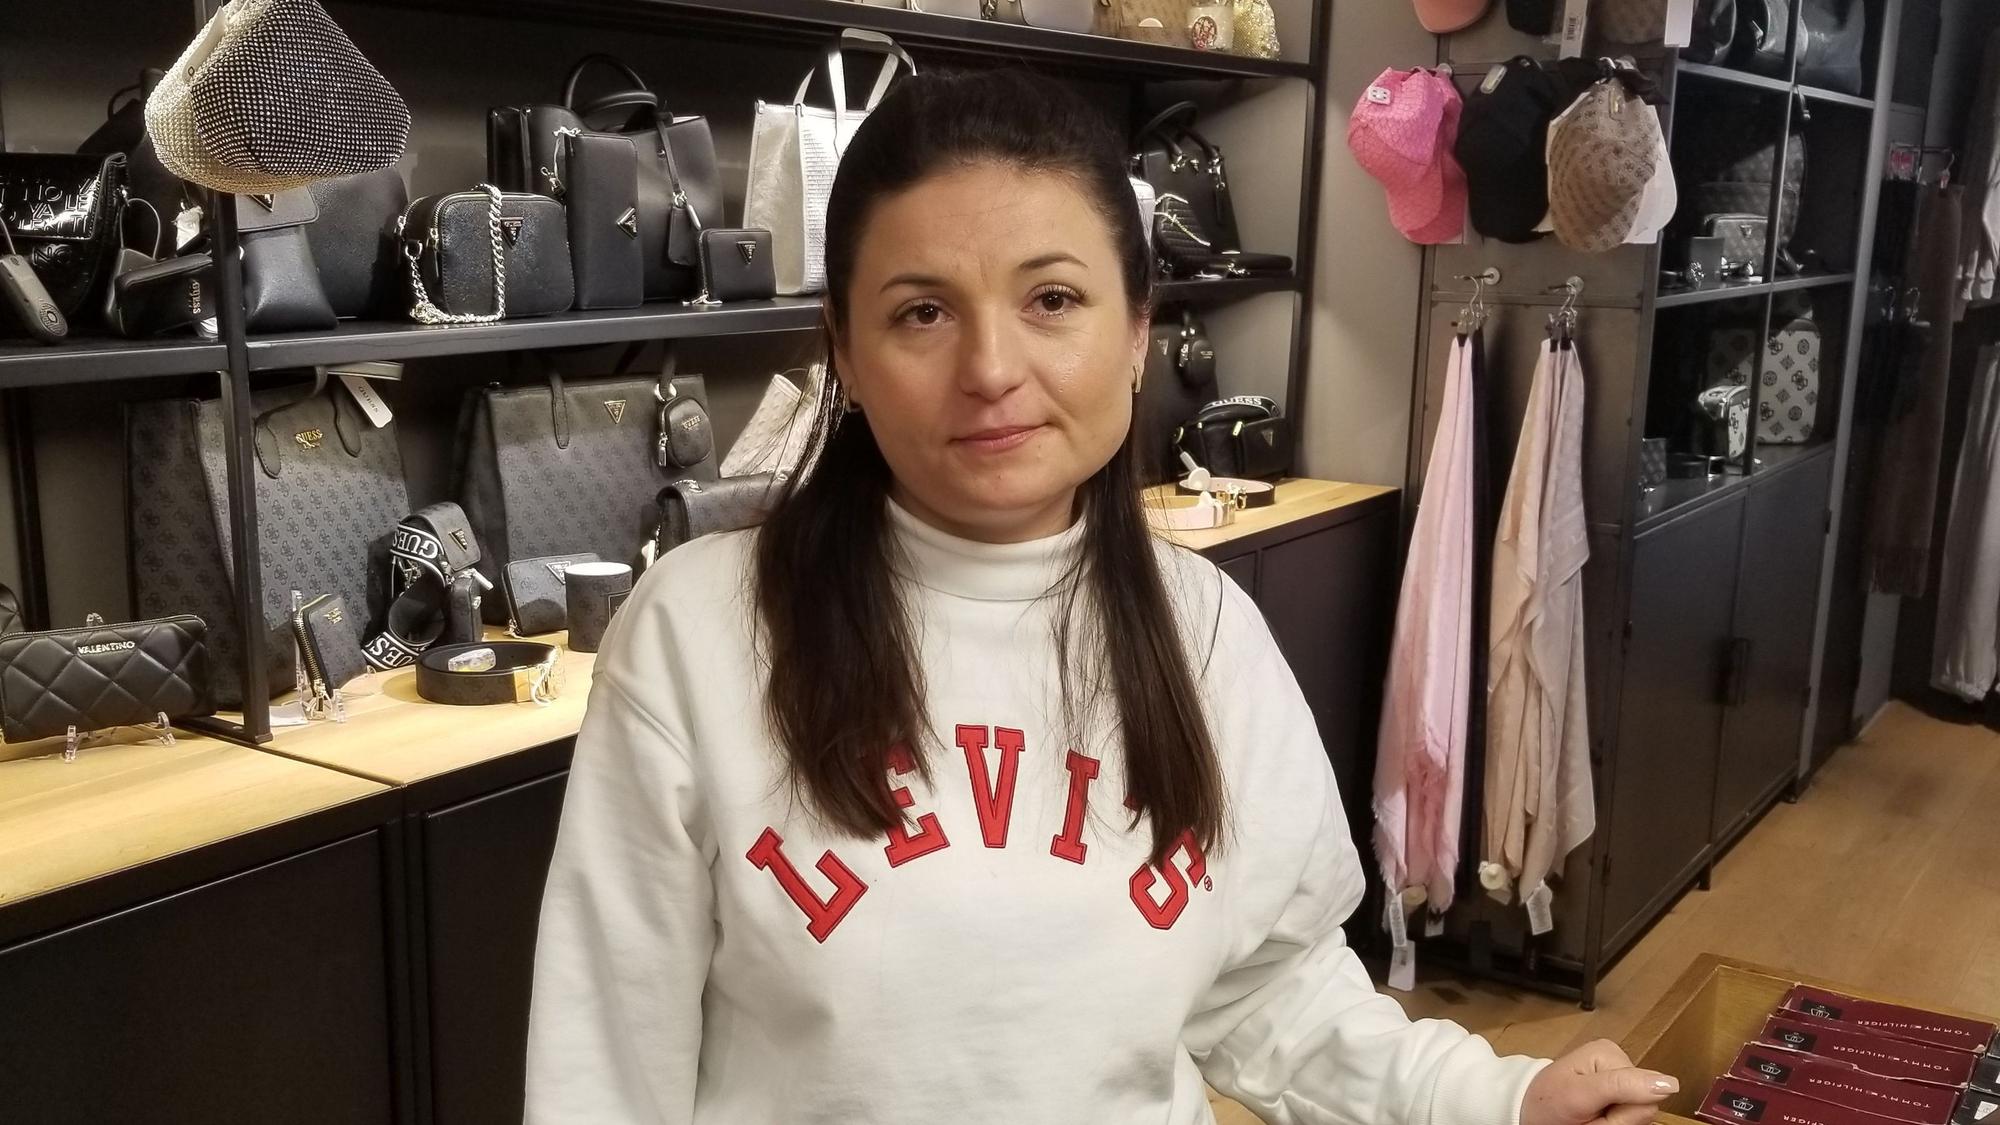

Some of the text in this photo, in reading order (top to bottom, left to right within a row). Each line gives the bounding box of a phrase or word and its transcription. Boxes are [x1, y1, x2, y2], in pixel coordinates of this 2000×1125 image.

[392, 529, 439, 559] GUES
[77, 640, 136, 654] VALENTINO
[746, 724, 1206, 944] LEVIS
[1857, 1020, 1971, 1037] TOMMY HILFIGER
[1833, 1045, 1951, 1072] TOMMY HILFIGER
[1809, 1078, 1931, 1109] TOMMY HILFIGER
